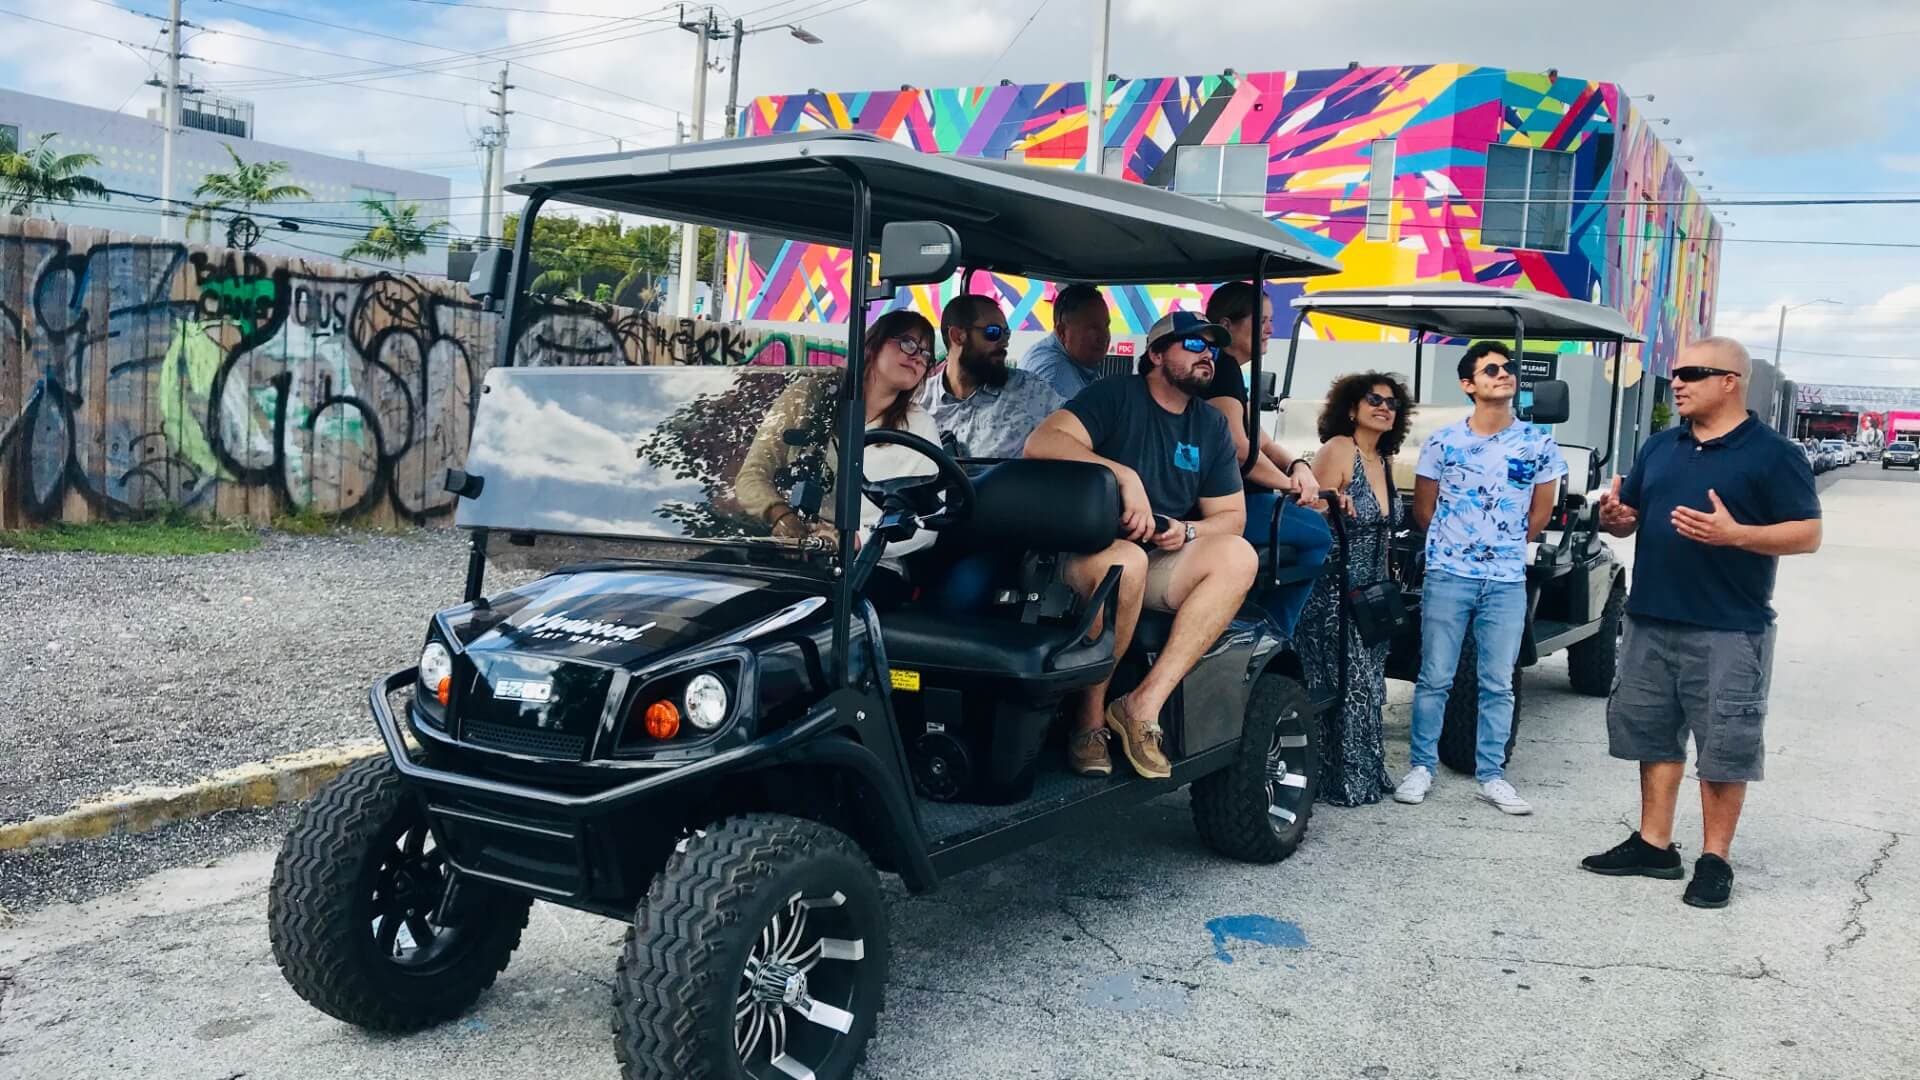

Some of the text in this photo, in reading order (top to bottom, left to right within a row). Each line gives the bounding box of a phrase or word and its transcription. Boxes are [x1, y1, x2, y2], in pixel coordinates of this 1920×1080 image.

[1118, 345, 1133, 353] FDC
[532, 631, 613, 647] ART WALK
